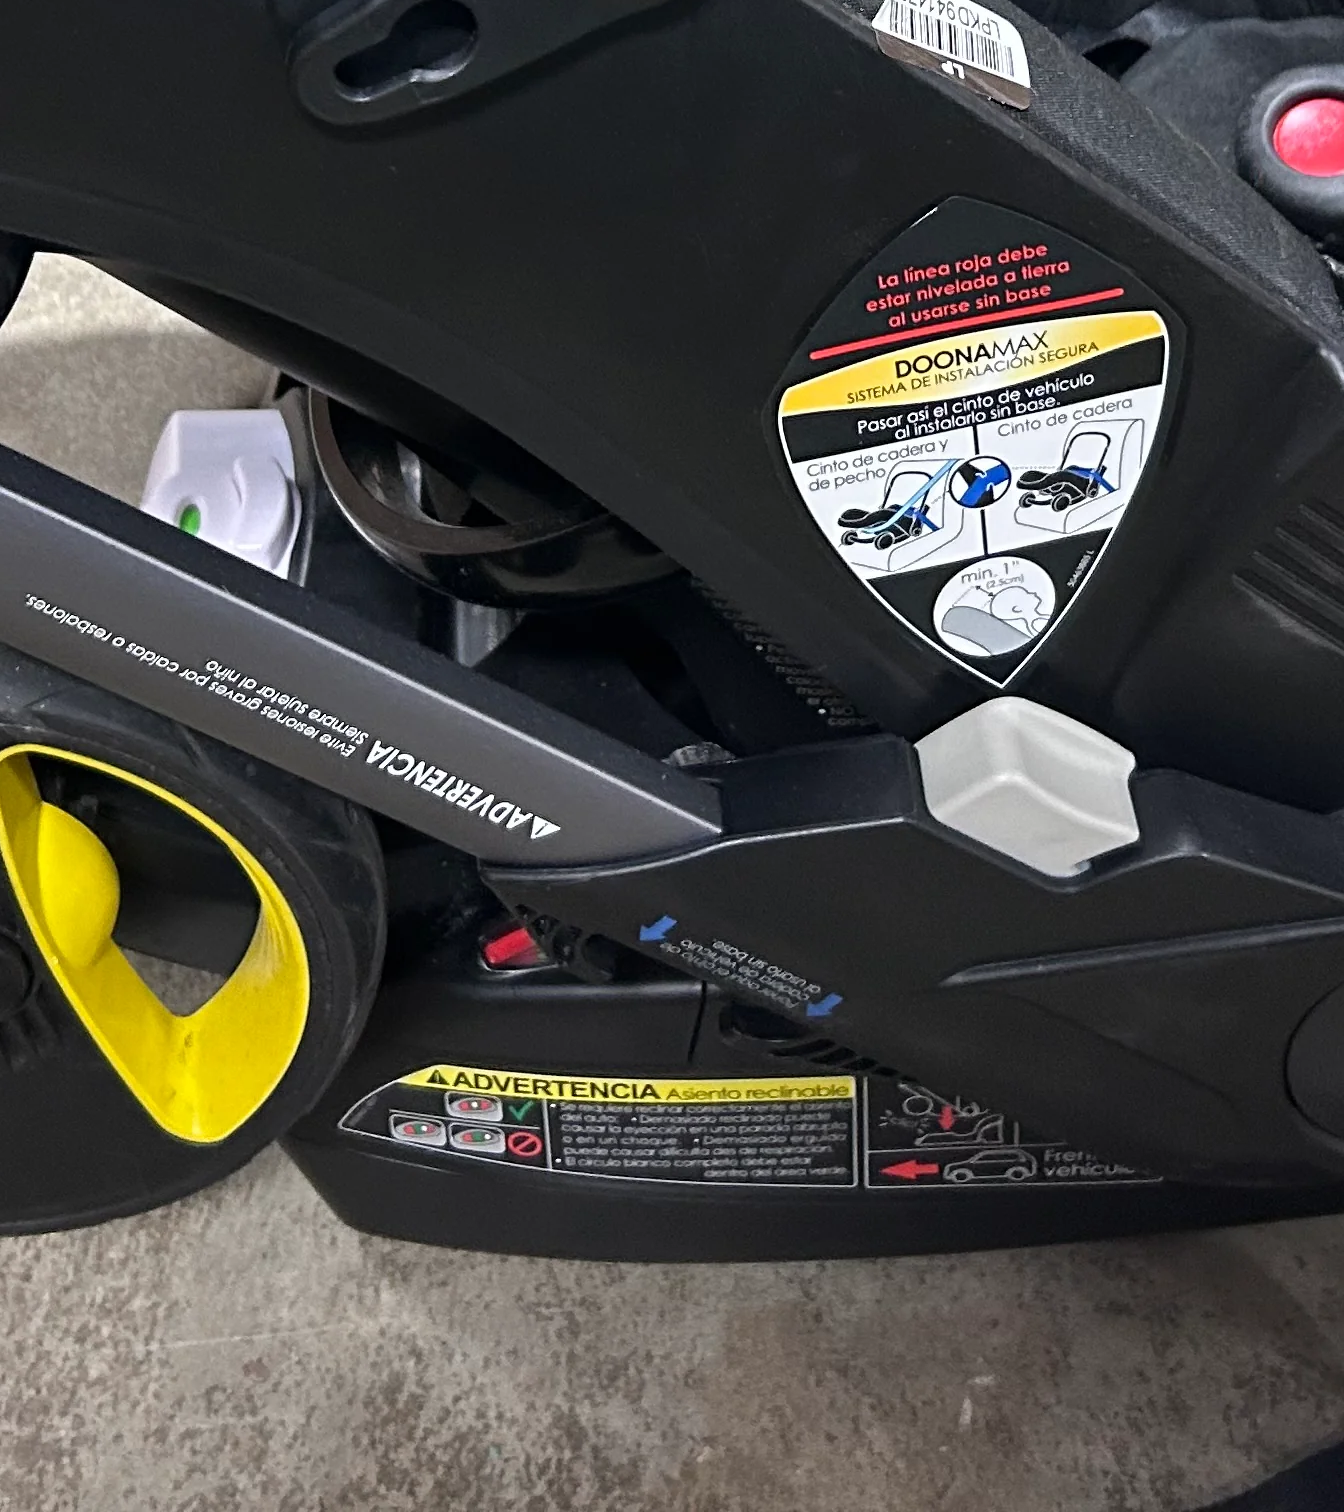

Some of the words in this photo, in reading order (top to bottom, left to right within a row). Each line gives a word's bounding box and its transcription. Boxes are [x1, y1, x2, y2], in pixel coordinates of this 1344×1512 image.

[941, 60, 966, 80] LP
[878, 273, 899, 289] La
[903, 262, 951, 284] línea
[955, 254, 992, 274] roja
[996, 243, 1048, 264] debe
[866, 292, 912, 312] estar
[916, 273, 999, 302] nivelada
[1004, 272, 1016, 284] a
[1021, 260, 1070, 280] tierra
[888, 312, 906, 328] al
[910, 300, 970, 322] usarse
[975, 292, 1000, 310] sin
[1005, 284, 1052, 304] base
[846, 380, 906, 404] SISTEMA
[910, 376, 930, 390] DE
[934, 352, 1034, 385] INSTALACIÓN
[1038, 341, 1100, 364] SEGURA
[894, 330, 1051, 378] DOONAMAX
[856, 413, 904, 434] Pasar
[906, 405, 930, 424] así
[932, 402, 948, 418] el
[951, 394, 994, 414] cinto
[1002, 388, 1020, 403] de
[1024, 372, 1095, 398] vehículo
[894, 424, 910, 440] al
[912, 410, 988, 436] instalarlo
[989, 404, 1012, 420] sin
[1014, 395, 1060, 414] base.
[996, 417, 1042, 437] Cinto
[1045, 412, 1068, 427] de
[1072, 397, 1133, 421] cadera
[806, 458, 848, 477] Cinto
[852, 454, 874, 468] de
[876, 440, 936, 462] cadera
[938, 439, 949, 452] y
[808, 478, 830, 492] de
[834, 466, 888, 489] pecho
[960, 567, 998, 584] min.
[23, 591, 112, 644] resbalones.
[110, 634, 126, 648] o
[124, 640, 180, 675] caídas
[178, 664, 211, 686] por
[204, 658, 240, 684] niño
[237, 674, 258, 691] al
[208, 674, 262, 712] graves
[254, 680, 310, 717] sujetar
[260, 703, 320, 740] lesiones
[308, 706, 370, 746] Siempre
[318, 731, 356, 758] Evite
[364, 736, 534, 836] ADVERTENCIA
[748, 955, 768, 970] sin
[766, 964, 806, 988] usarlo
[806, 982, 821, 995] al
[453, 1072, 661, 1100] ADVERTENCIA
[666, 1085, 740, 1100] Asiento
[746, 1083, 850, 1100] reclinable
